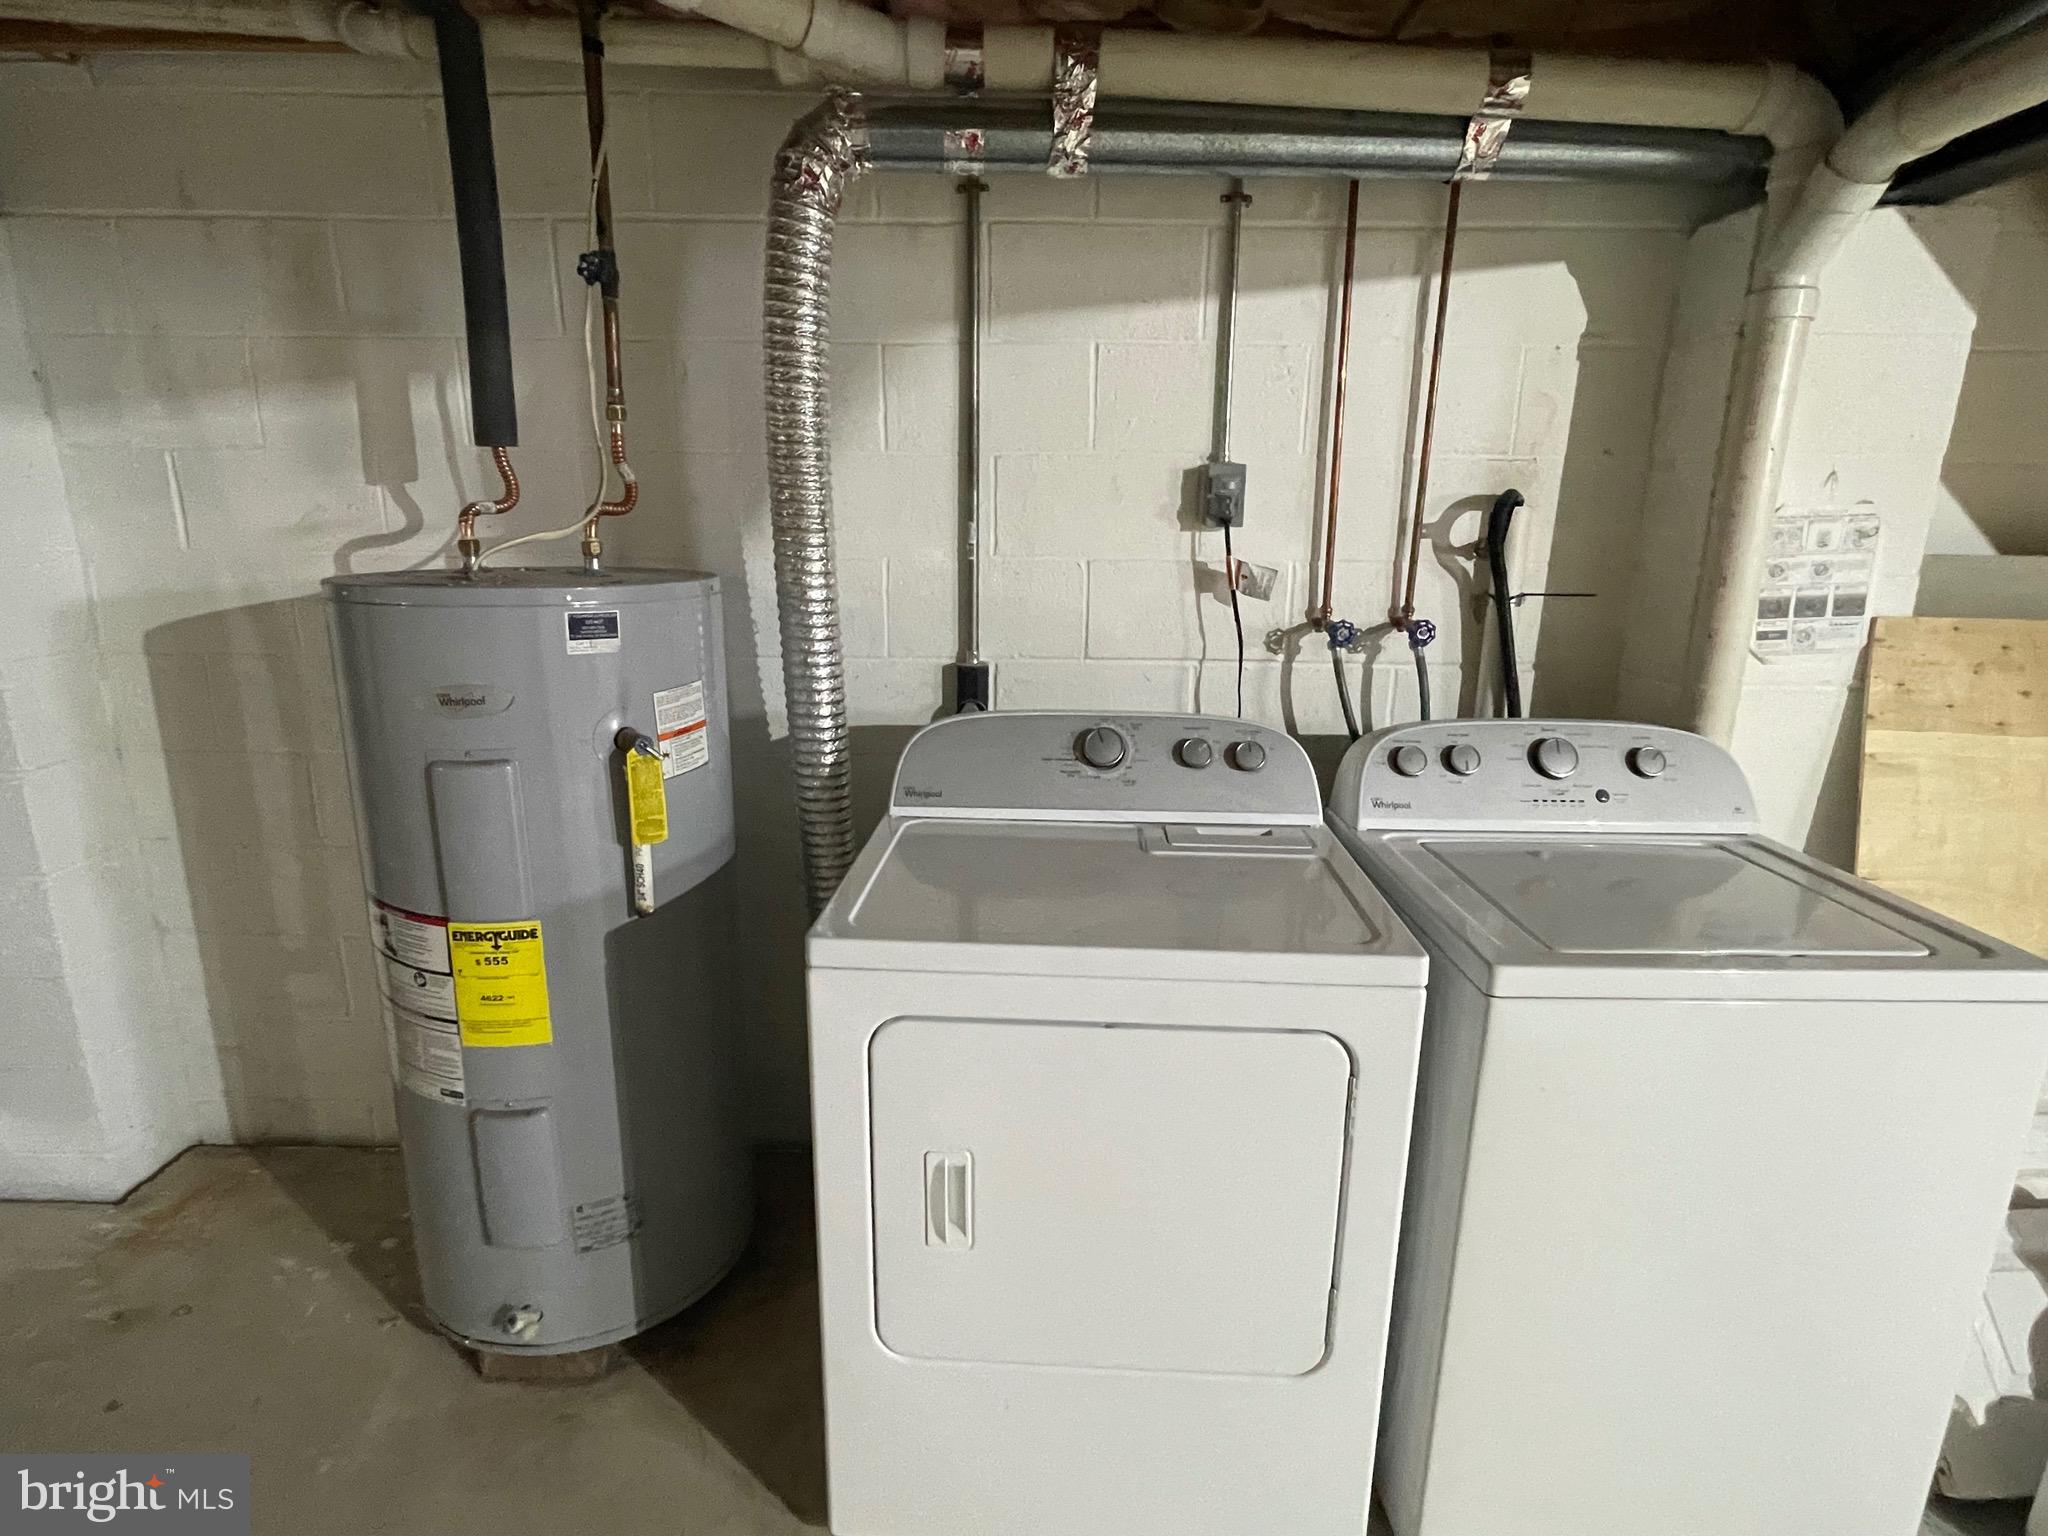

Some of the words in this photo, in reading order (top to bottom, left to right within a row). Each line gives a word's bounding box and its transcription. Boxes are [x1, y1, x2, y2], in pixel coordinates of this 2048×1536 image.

[438, 694, 486, 708] Whirlpool
[904, 788, 943, 799] Whirlpool
[1371, 800, 1412, 811] Whirlpool
[484, 956, 509, 966] 555
